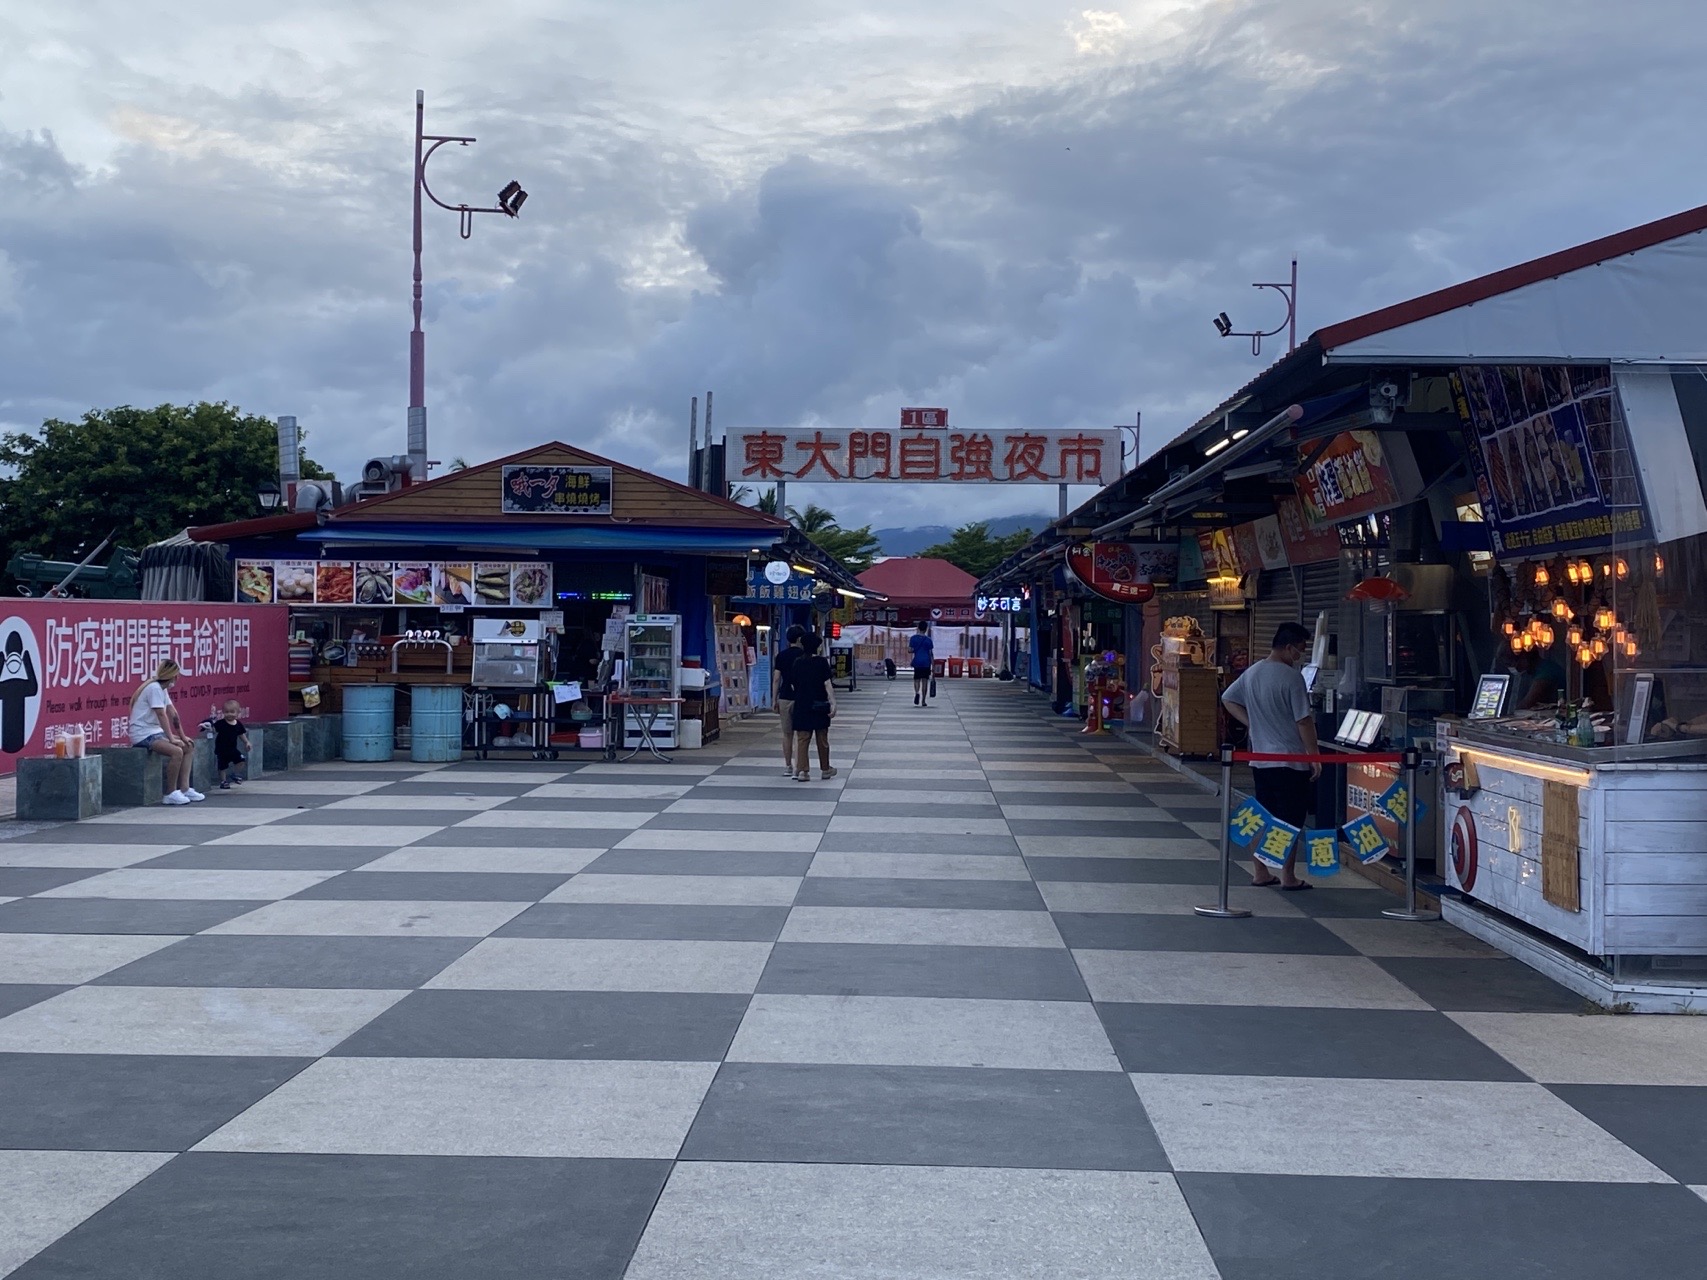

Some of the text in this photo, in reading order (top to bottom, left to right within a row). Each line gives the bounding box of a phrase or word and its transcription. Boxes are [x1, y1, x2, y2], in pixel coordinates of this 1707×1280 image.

[909, 410, 938, 425] 1區
[742, 430, 1104, 482] 東大門自強夜市
[564, 474, 590, 489] 海鮮
[977, 597, 1022, 612] 妙不可言
[46, 617, 250, 688] 防疫期間請走檢測門
[180, 686, 188, 699] the
[46, 699, 66, 714] Please
[69, 697, 82, 712] walk
[86, 694, 107, 711] through
[111, 694, 120, 707] the
